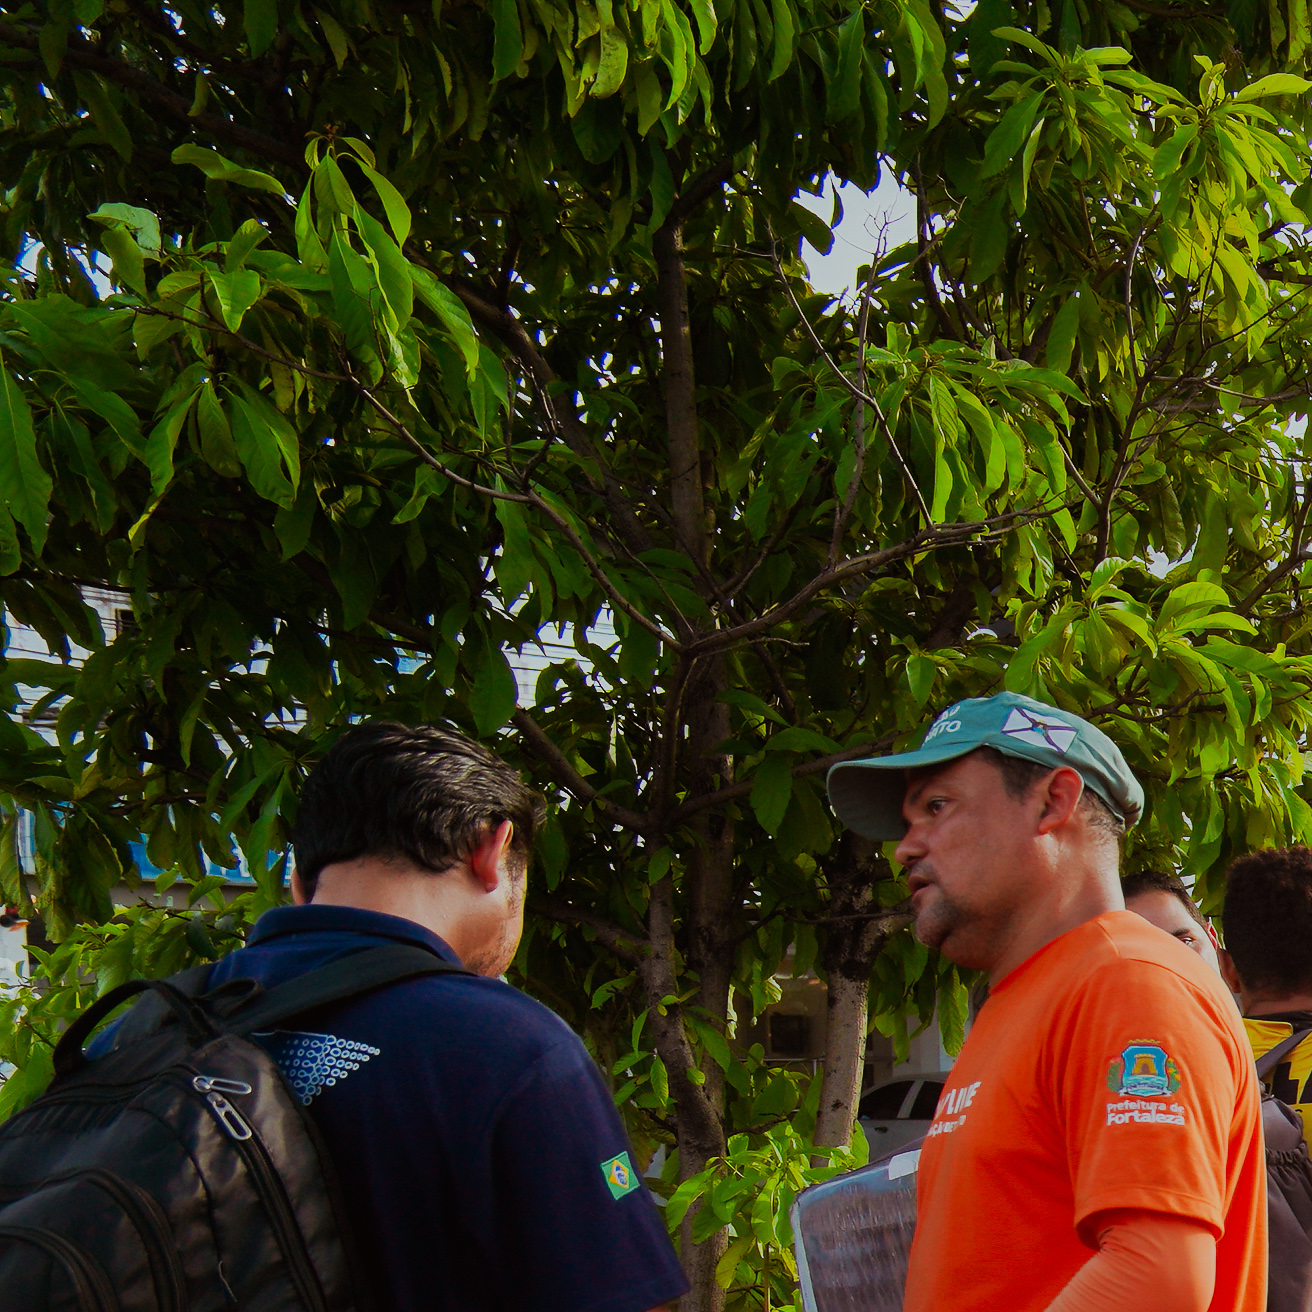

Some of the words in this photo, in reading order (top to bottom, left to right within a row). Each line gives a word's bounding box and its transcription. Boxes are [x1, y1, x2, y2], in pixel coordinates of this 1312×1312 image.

[1107, 1100, 1167, 1113] Prefeitura
[1169, 1101, 1185, 1114] de
[1107, 1111, 1186, 1126] Fortaleza
